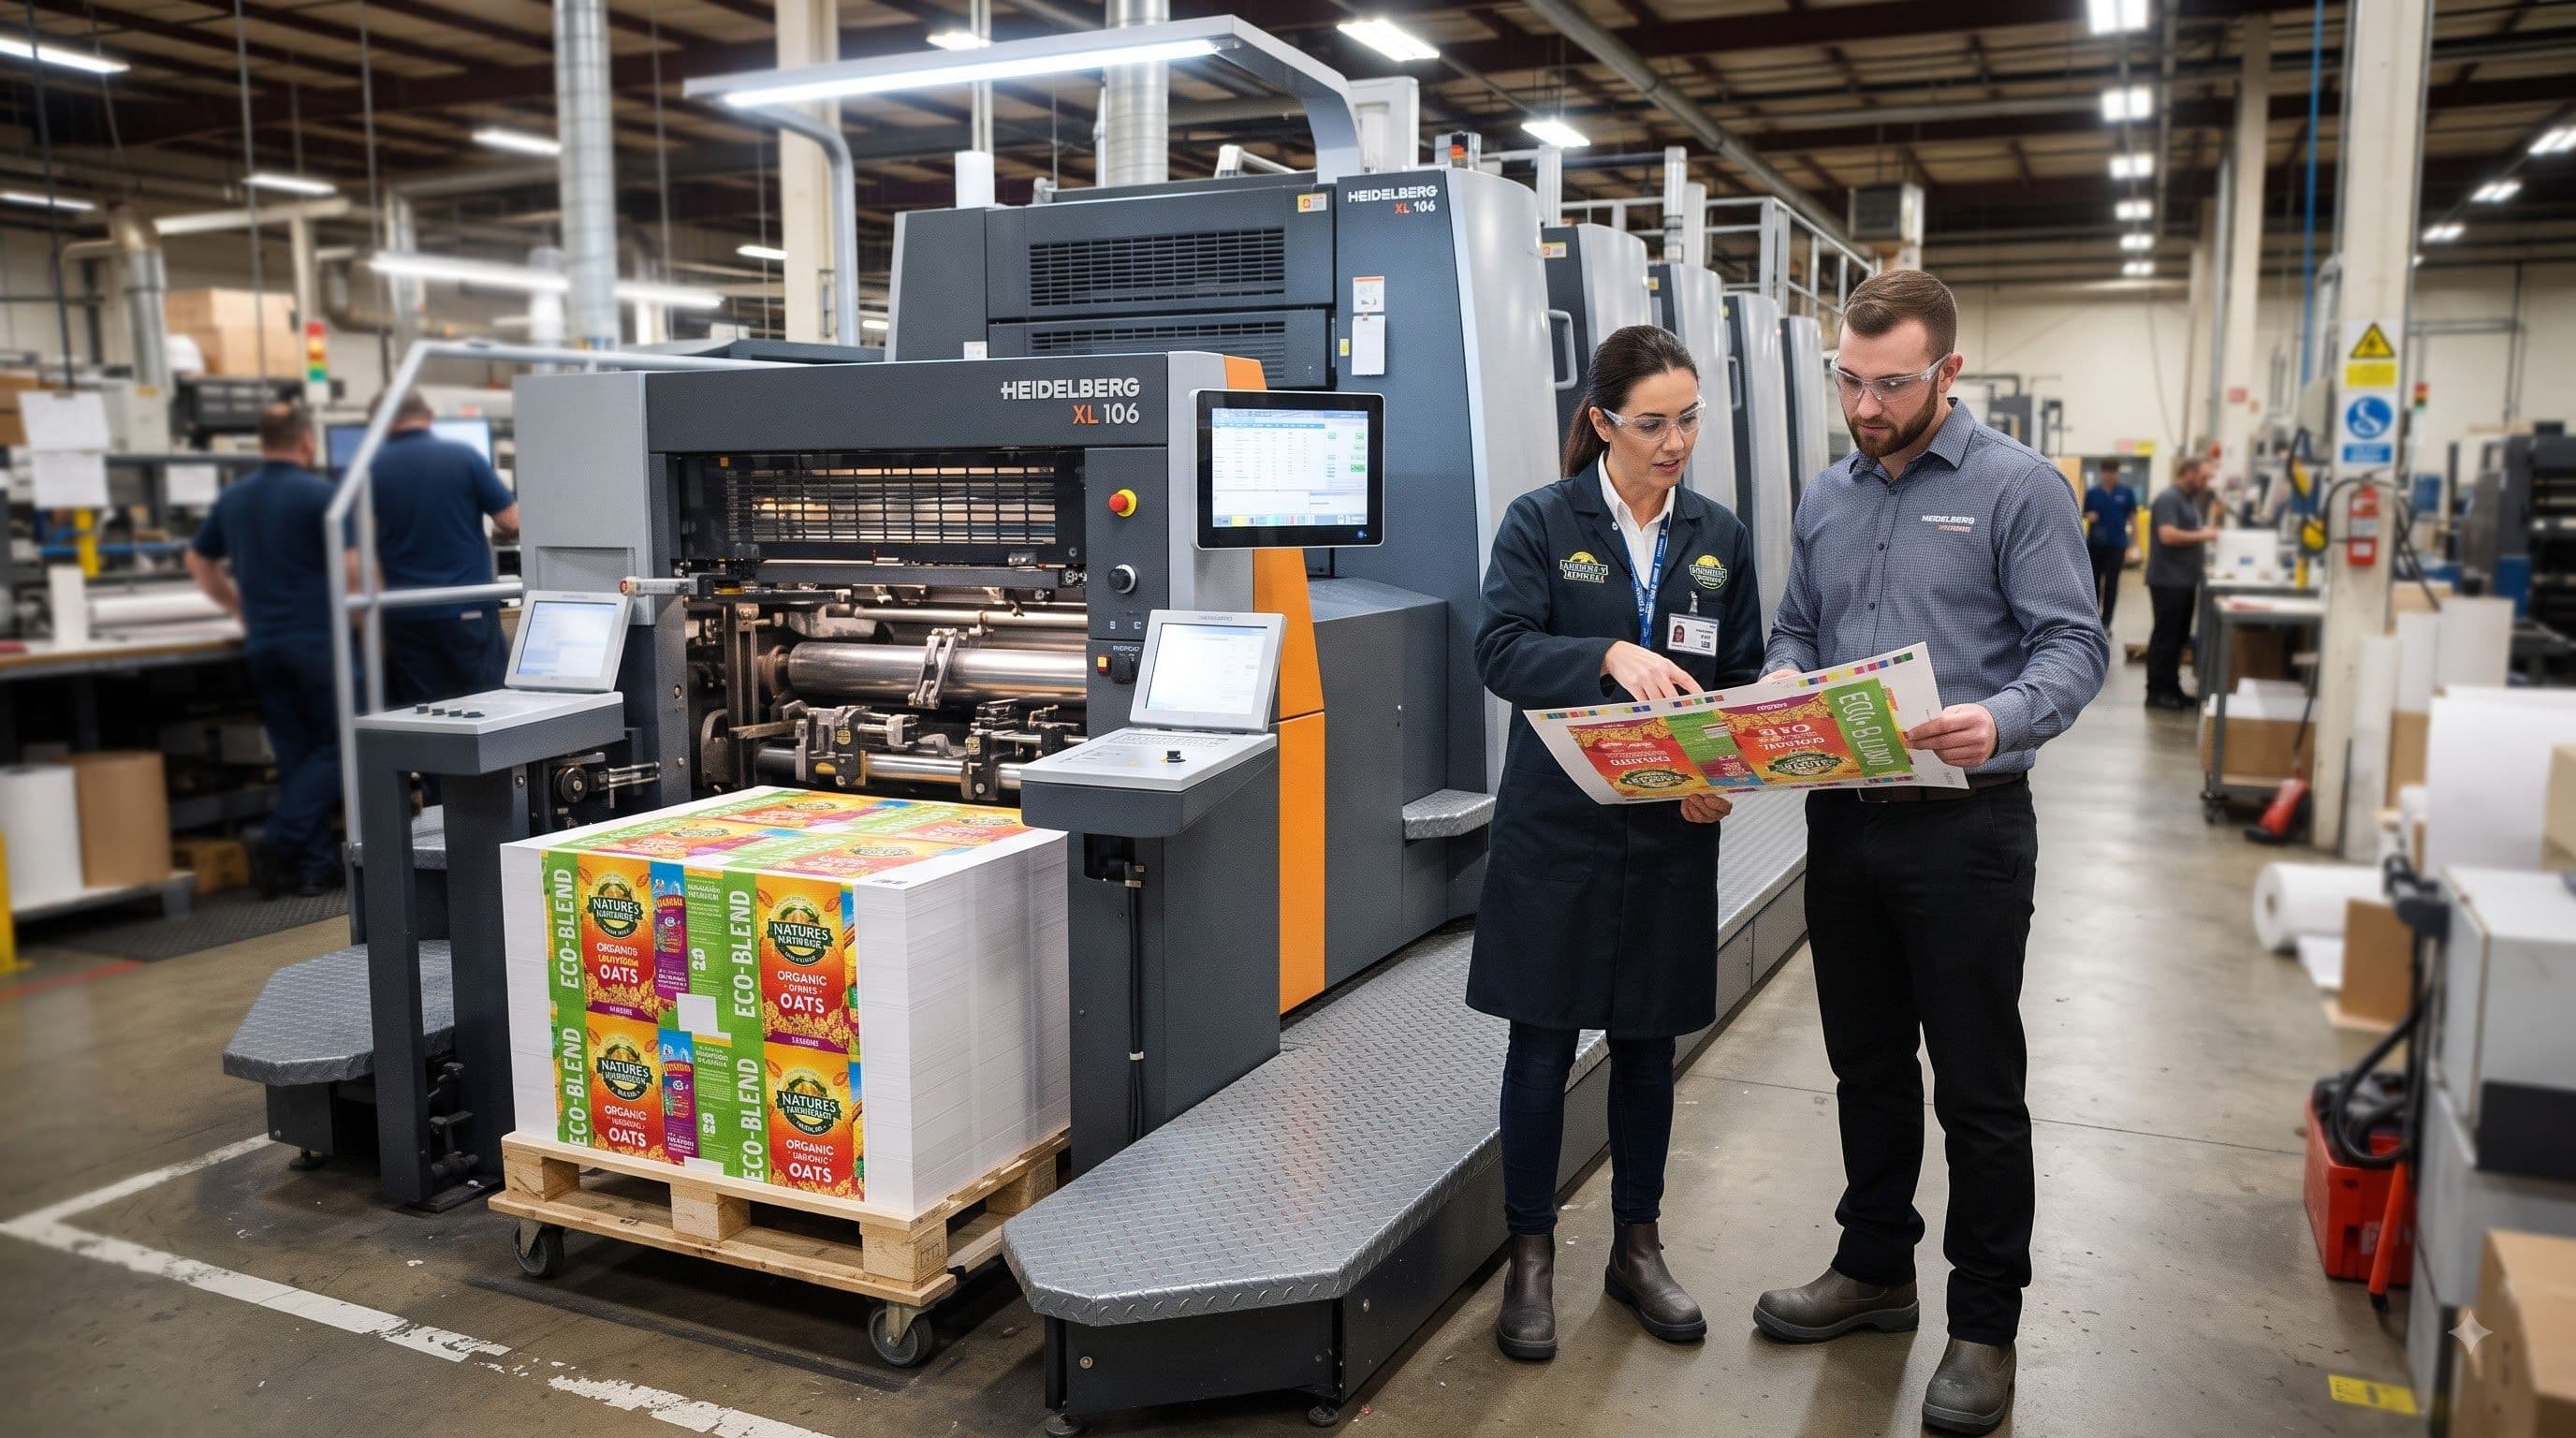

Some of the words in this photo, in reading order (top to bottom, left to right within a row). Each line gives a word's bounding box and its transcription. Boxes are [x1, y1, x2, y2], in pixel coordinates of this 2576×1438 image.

[1347, 185, 1438, 202] HEIDELBERG
[1394, 202, 1410, 214] XL
[1413, 200, 1436, 213] 106
[1000, 377, 1140, 400] HEIDELBERG
[1072, 404, 1099, 424] XL
[1104, 403, 1140, 424] 106
[593, 898, 639, 915] NATURES
[553, 869, 579, 990] ECO-BLEND
[773, 923, 828, 940] NATURES
[729, 890, 756, 1018] ECO-BLEND
[600, 964, 638, 984] OATS
[777, 970, 827, 986] ORGANIC
[780, 992, 825, 1014] OATS
[601, 1060, 650, 1078] NATURES
[562, 1027, 588, 1147] ECO-BLEND
[604, 1105, 647, 1121] ORGANIC
[782, 1093, 836, 1113] NATURES
[737, 1058, 765, 1182] ECO-BLEND
[608, 1127, 647, 1148] OATS
[785, 1139, 834, 1156] ORGANIC
[788, 1163, 832, 1183] OATS
